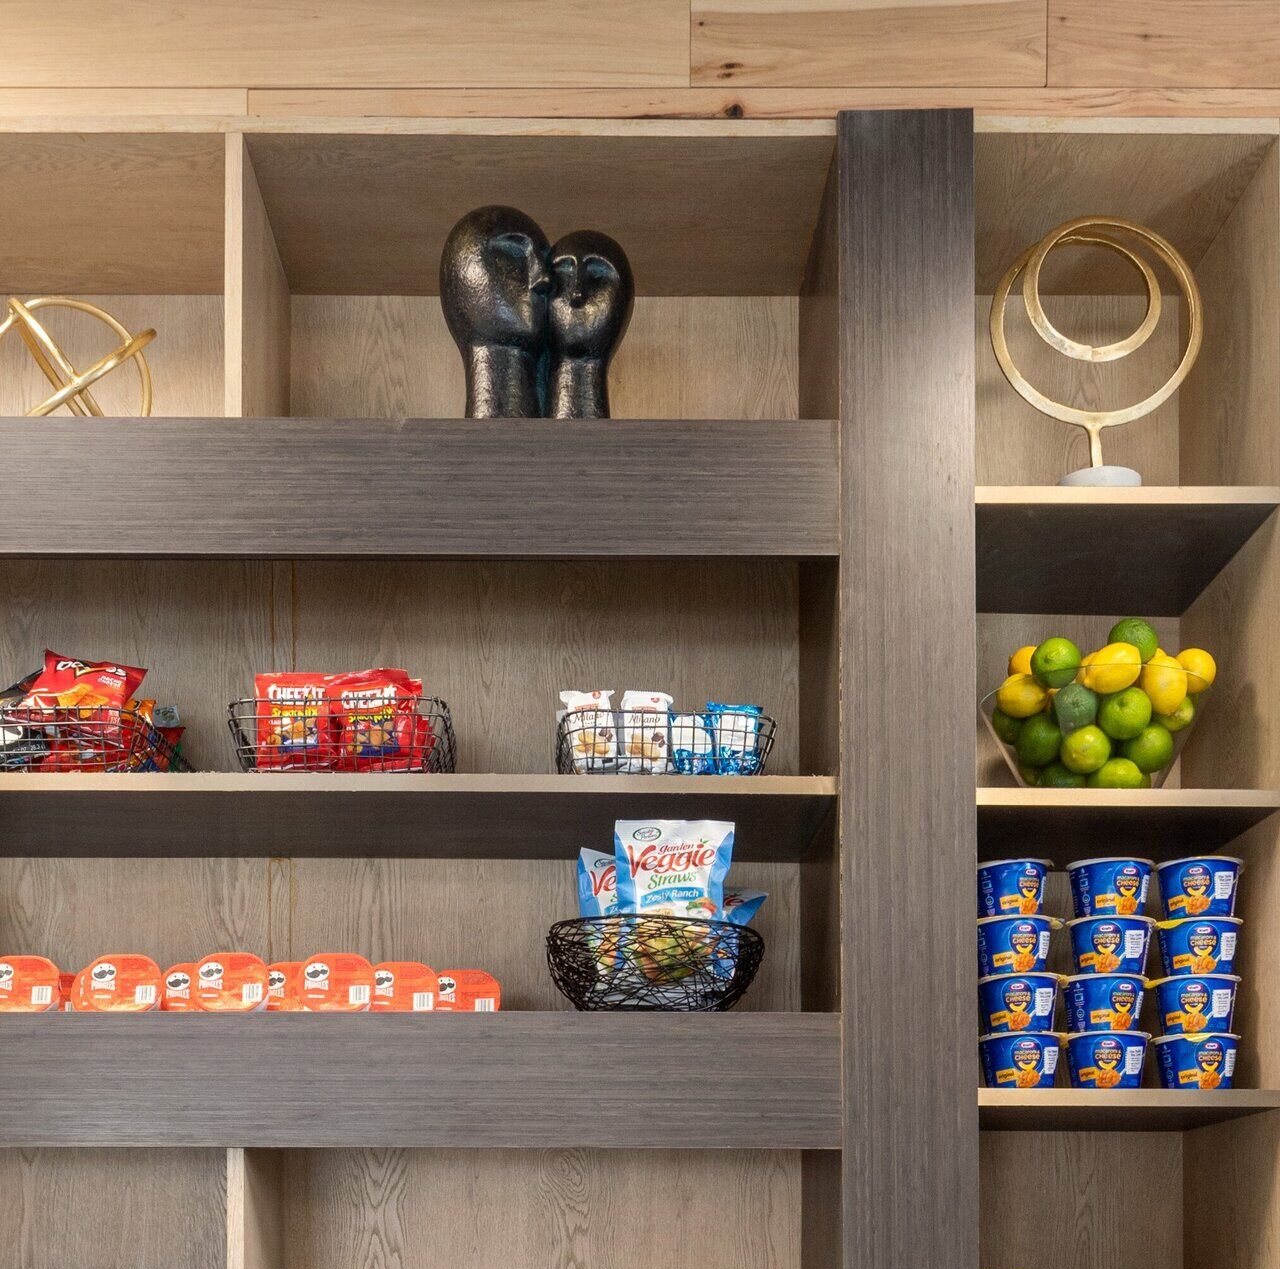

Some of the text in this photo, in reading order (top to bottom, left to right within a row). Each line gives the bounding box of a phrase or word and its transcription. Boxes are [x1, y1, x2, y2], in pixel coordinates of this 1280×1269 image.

[660, 843, 694, 853] garden
[627, 845, 716, 878] Veggie
[648, 871, 697, 889] Straws
[646, 889, 699, 902] Zesty Ranch
